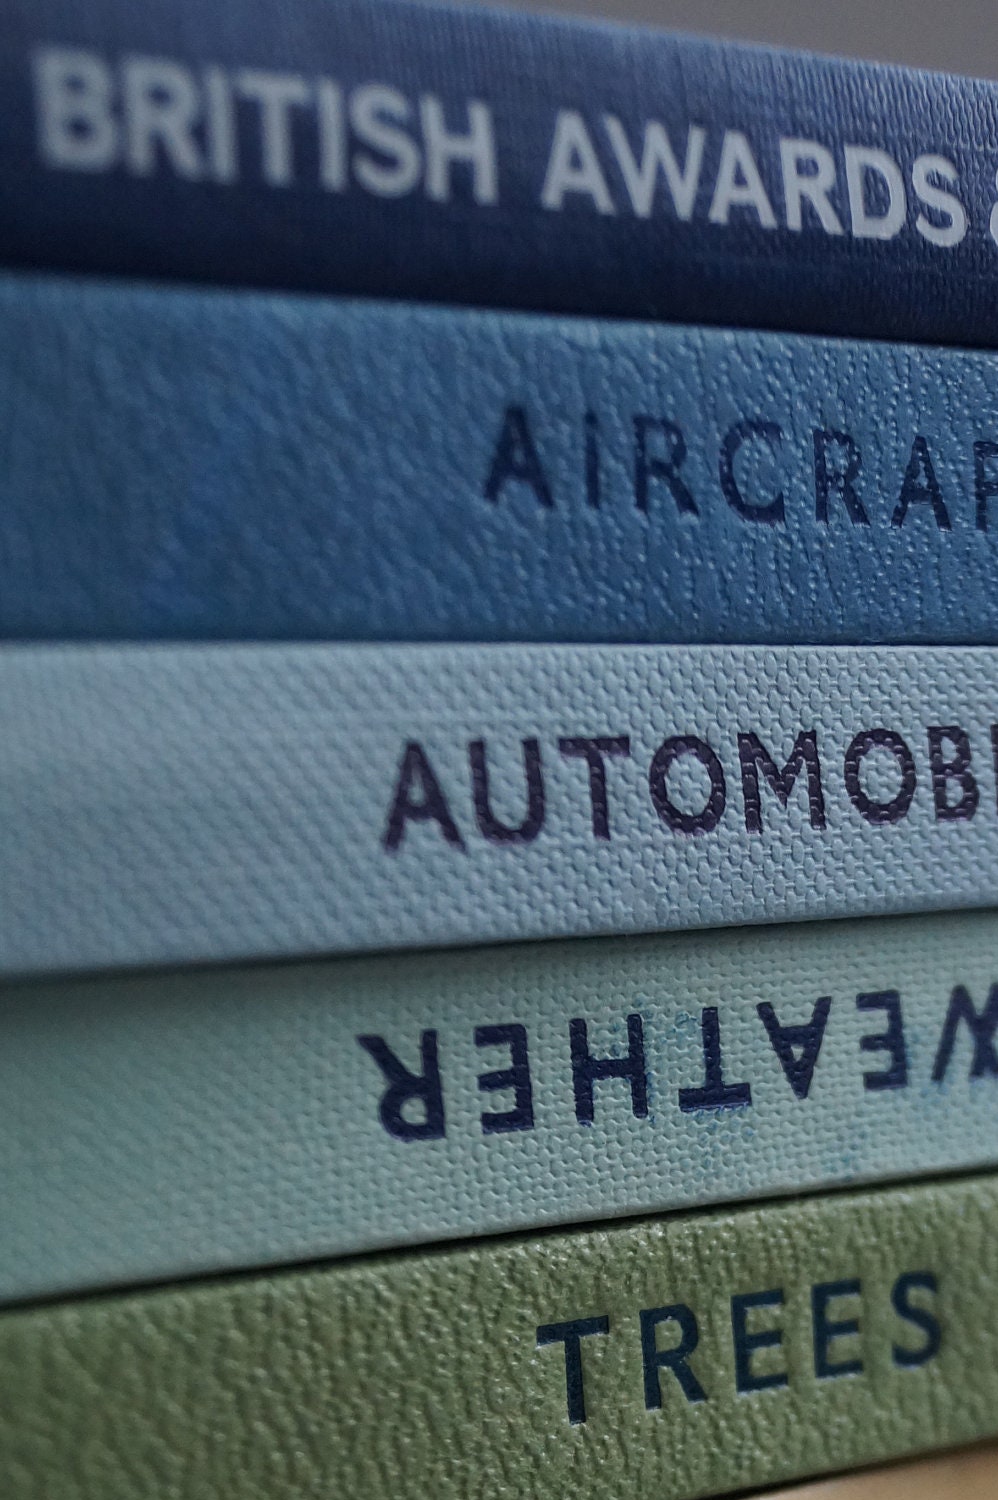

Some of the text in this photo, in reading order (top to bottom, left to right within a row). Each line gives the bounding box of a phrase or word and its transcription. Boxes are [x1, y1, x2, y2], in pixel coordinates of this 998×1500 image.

[30, 41, 500, 207] BRITISH
[541, 109, 968, 248] AWARDS
[536, 1271, 942, 1426] TREES
